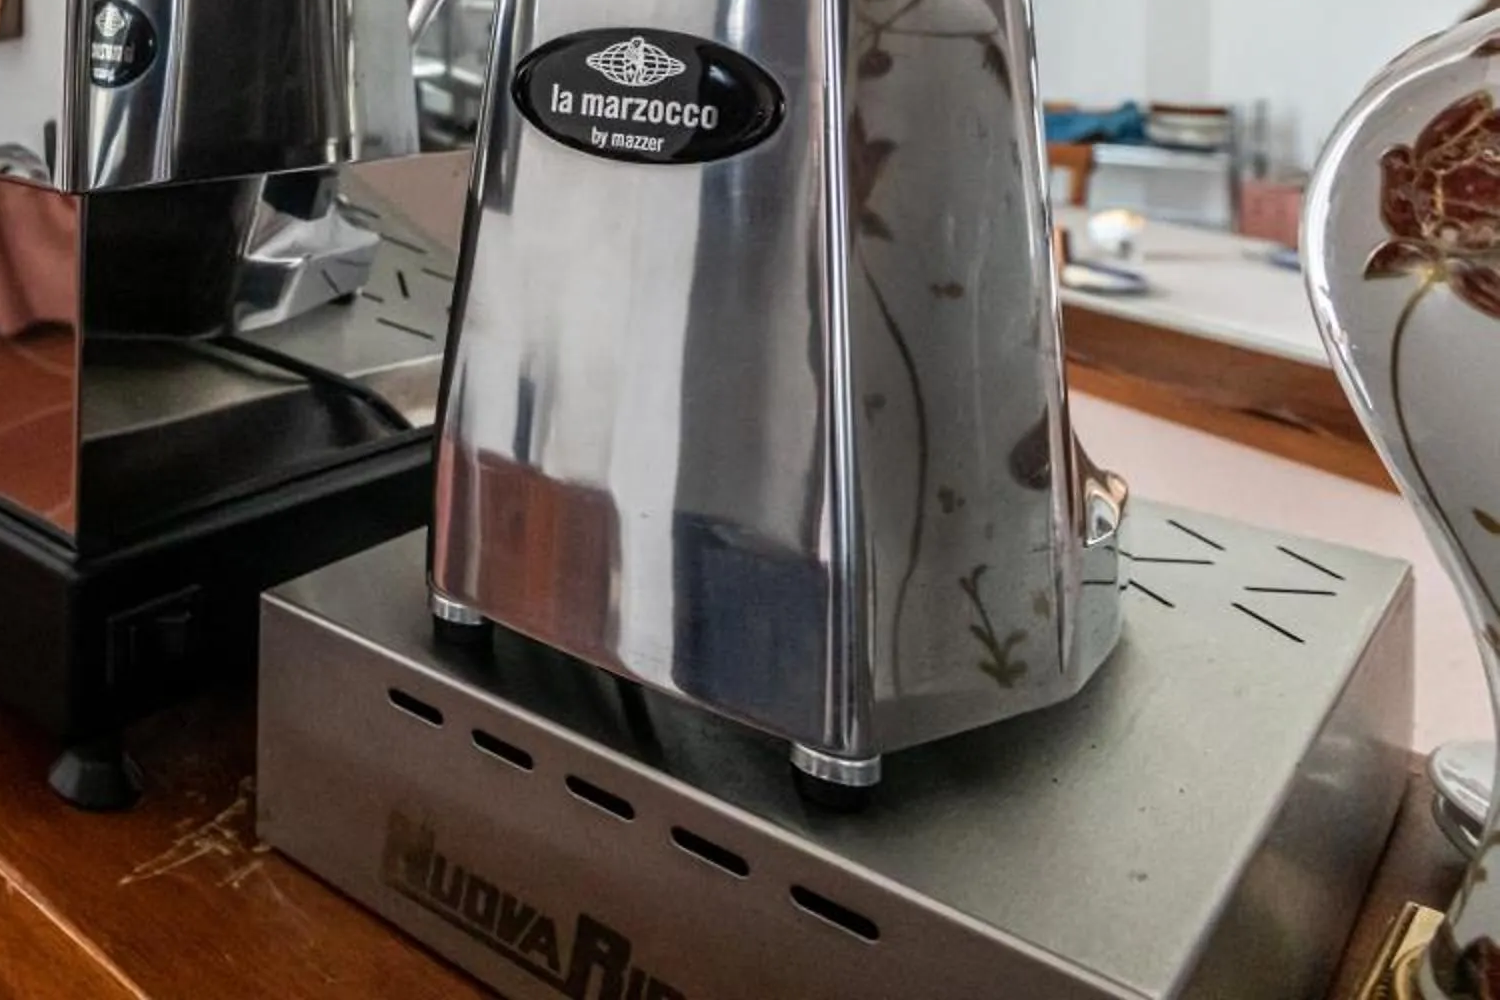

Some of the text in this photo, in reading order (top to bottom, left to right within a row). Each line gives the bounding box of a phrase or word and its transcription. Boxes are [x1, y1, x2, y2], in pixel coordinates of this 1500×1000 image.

[550, 83, 719, 130] la marzocco
[591, 127, 665, 152] by mazzer
